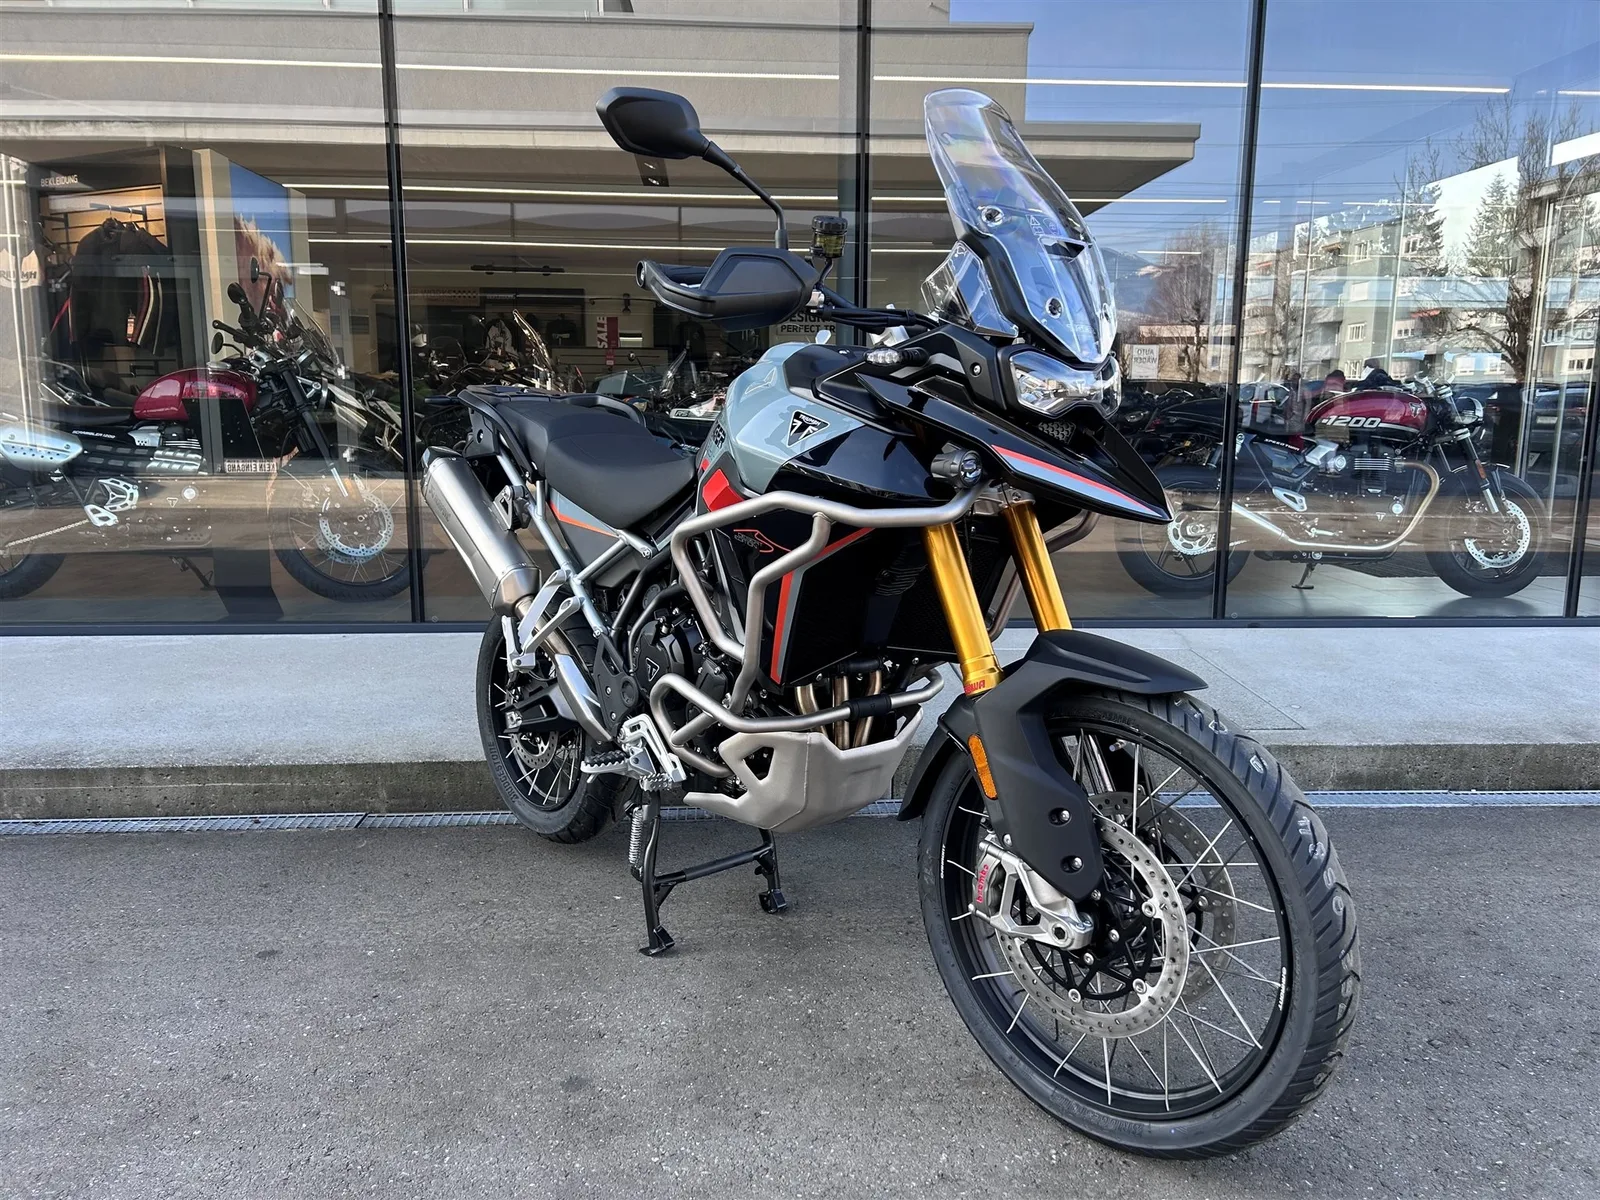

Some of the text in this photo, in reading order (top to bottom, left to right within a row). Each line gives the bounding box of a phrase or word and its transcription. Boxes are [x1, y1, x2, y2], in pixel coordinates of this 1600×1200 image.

[40, 174, 78, 187] BEKLEIDUNG
[596, 316, 608, 348] SALE
[780, 324, 820, 333] PERFECT
[799, 413, 822, 426] TRIUMPH
[1325, 415, 1381, 428] 1200
[71, 429, 103, 437] SCRAMBLER
[975, 864, 990, 904] brembo
